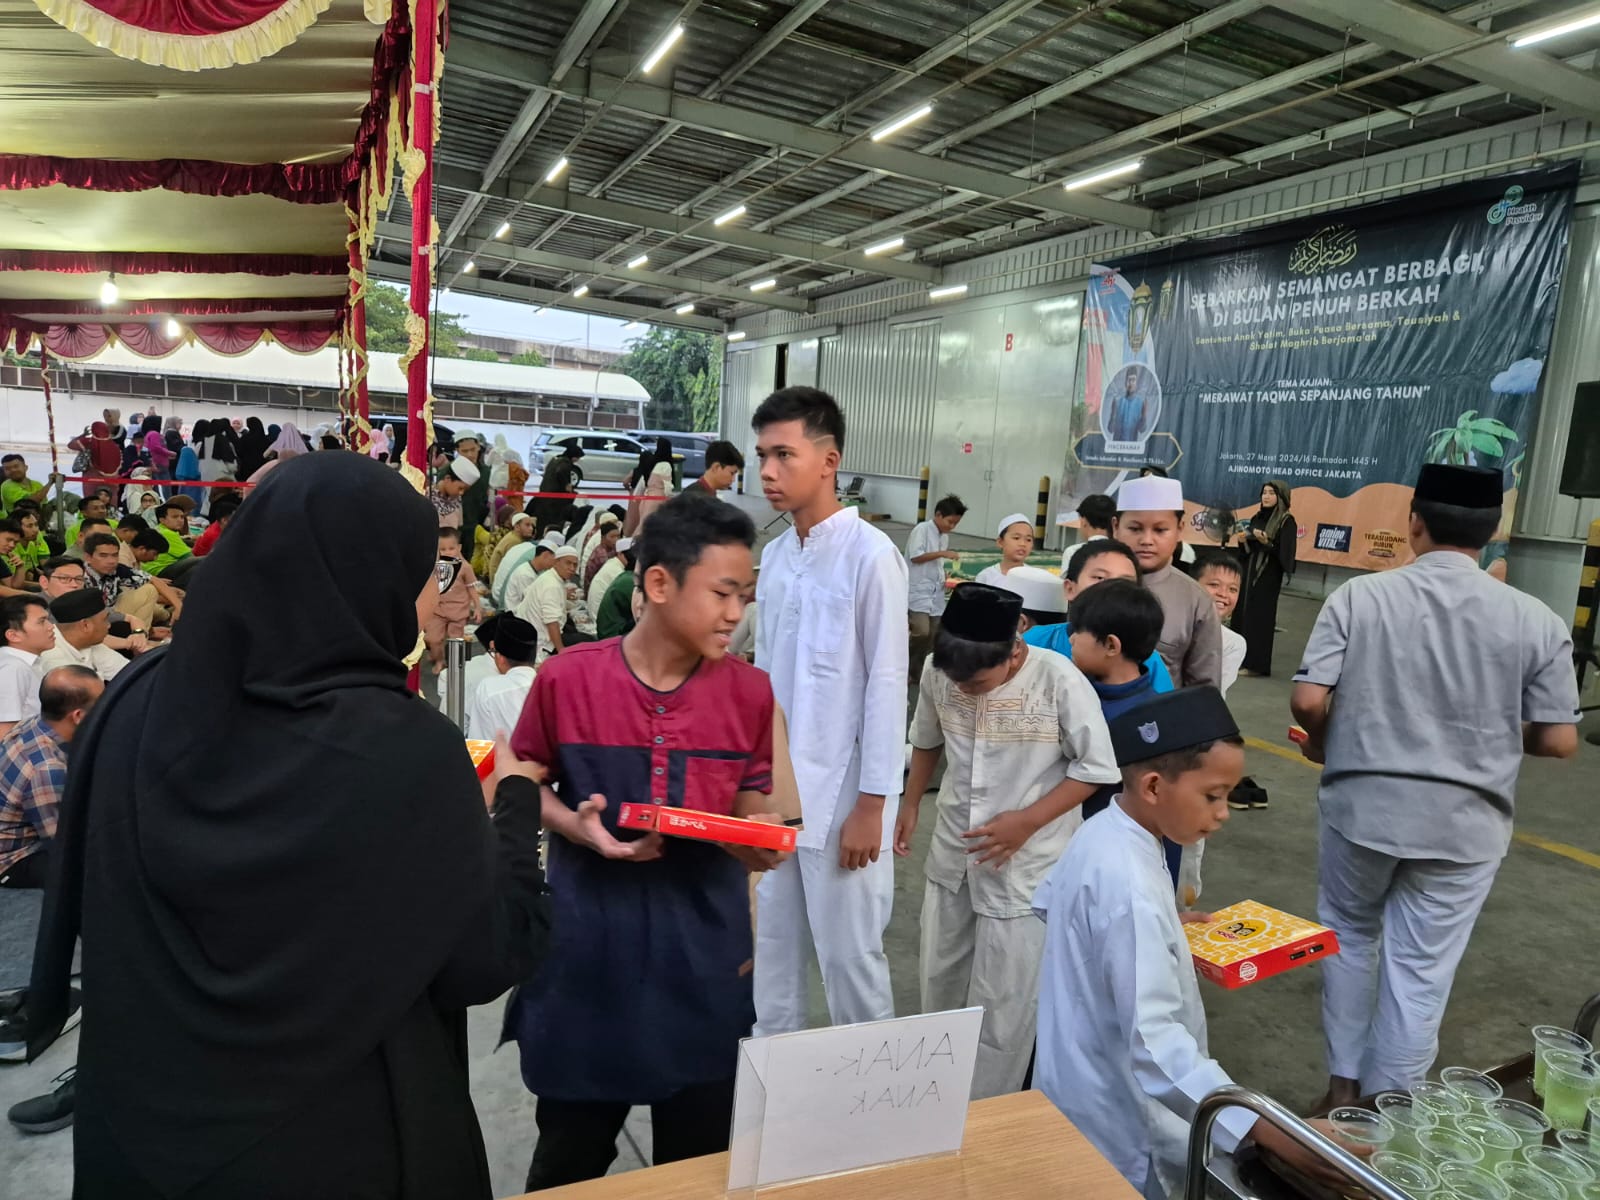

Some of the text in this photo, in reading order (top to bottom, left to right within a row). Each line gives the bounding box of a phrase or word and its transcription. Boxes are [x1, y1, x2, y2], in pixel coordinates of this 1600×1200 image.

[1190, 252, 1485, 310] SEBARKAN SEMANGAT BERBAGI,
[1213, 284, 1440, 327] DI BULAN PENUH BERKAH
[1234, 330, 1256, 342] Anak
[1258, 330, 1285, 340] Yatim,
[1288, 326, 1310, 336] Buka
[1313, 324, 1343, 333] Puasa
[1345, 319, 1393, 332] Bersama,
[1398, 311, 1449, 327] Tausiyah
[1452, 309, 1461, 321] &
[1005, 333, 1014, 351] B
[1280, 336, 1319, 350] Maghrib
[1321, 332, 1377, 346] Berjama'ah
[1277, 377, 1333, 389] TEMA KAJIAN:
[1256, 389, 1297, 404] TAQWA
[1299, 387, 1372, 402] SEPANJANG
[1376, 385, 1431, 400] TAHUN"
[1219, 450, 1245, 461] Jakarta,
[1247, 452, 1256, 461] 27
[1279, 453, 1310, 464] 2024/16
[1351, 456, 1369, 466] 1445
[1371, 457, 1378, 466] H
[1228, 464, 1362, 479] AJINOMOTO HEAD OFFICE JAKARTA
[1319, 527, 1345, 540] amino
